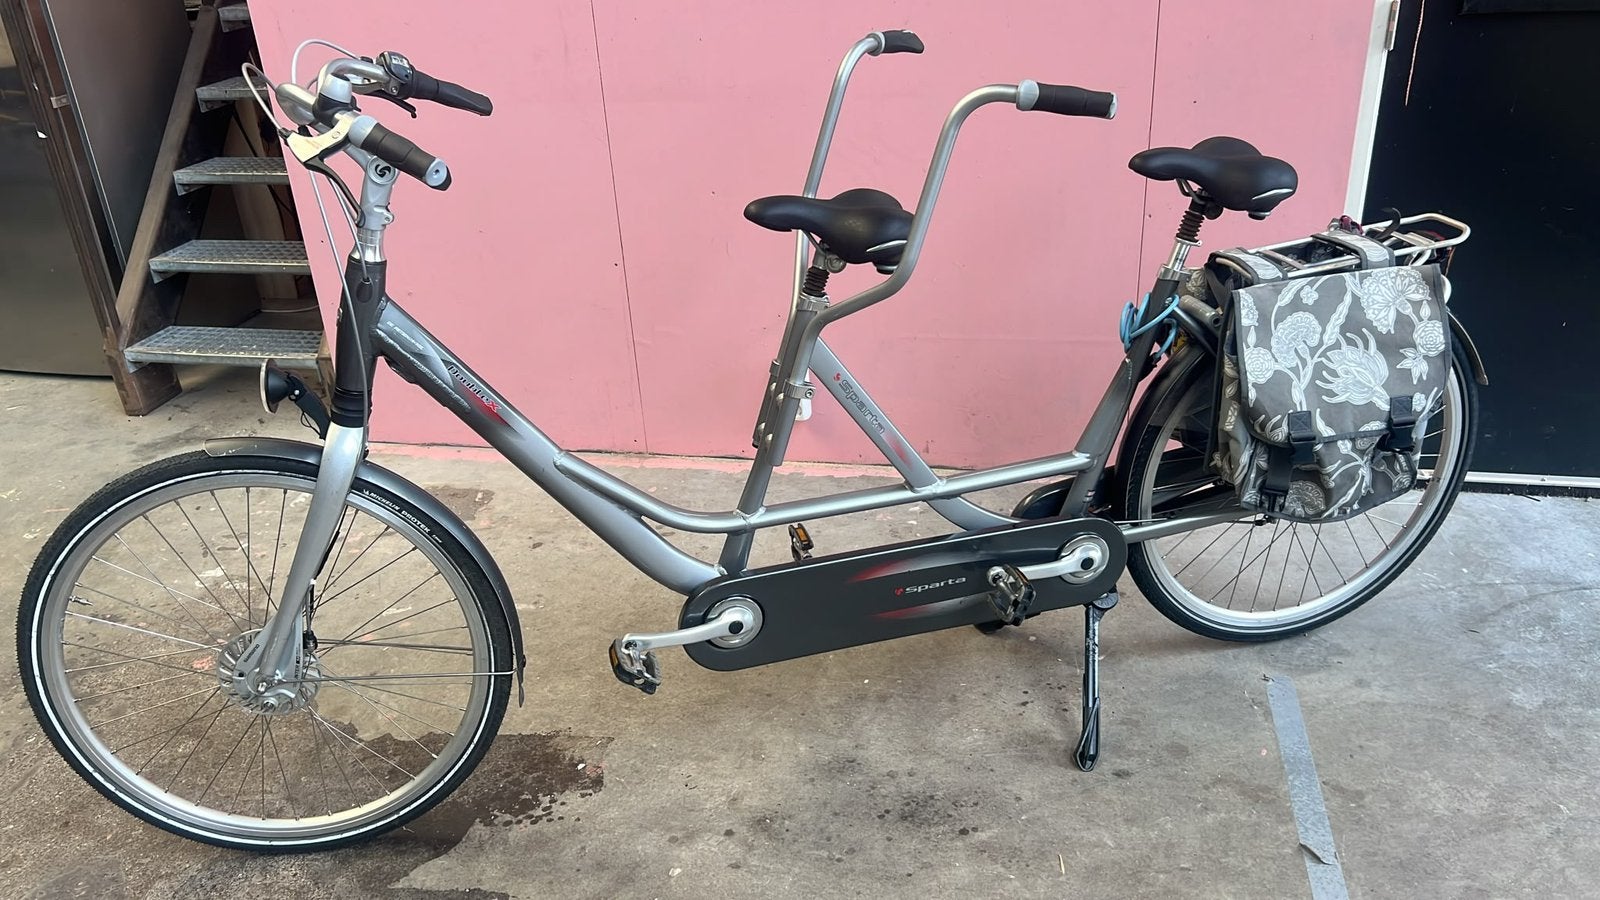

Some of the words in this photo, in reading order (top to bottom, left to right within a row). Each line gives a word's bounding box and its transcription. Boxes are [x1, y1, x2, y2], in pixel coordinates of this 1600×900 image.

[838, 378, 886, 434] Sparta
[370, 492, 401, 511] MICHELIN
[401, 510, 431, 534] PROTEK
[905, 576, 967, 594] Sparta
